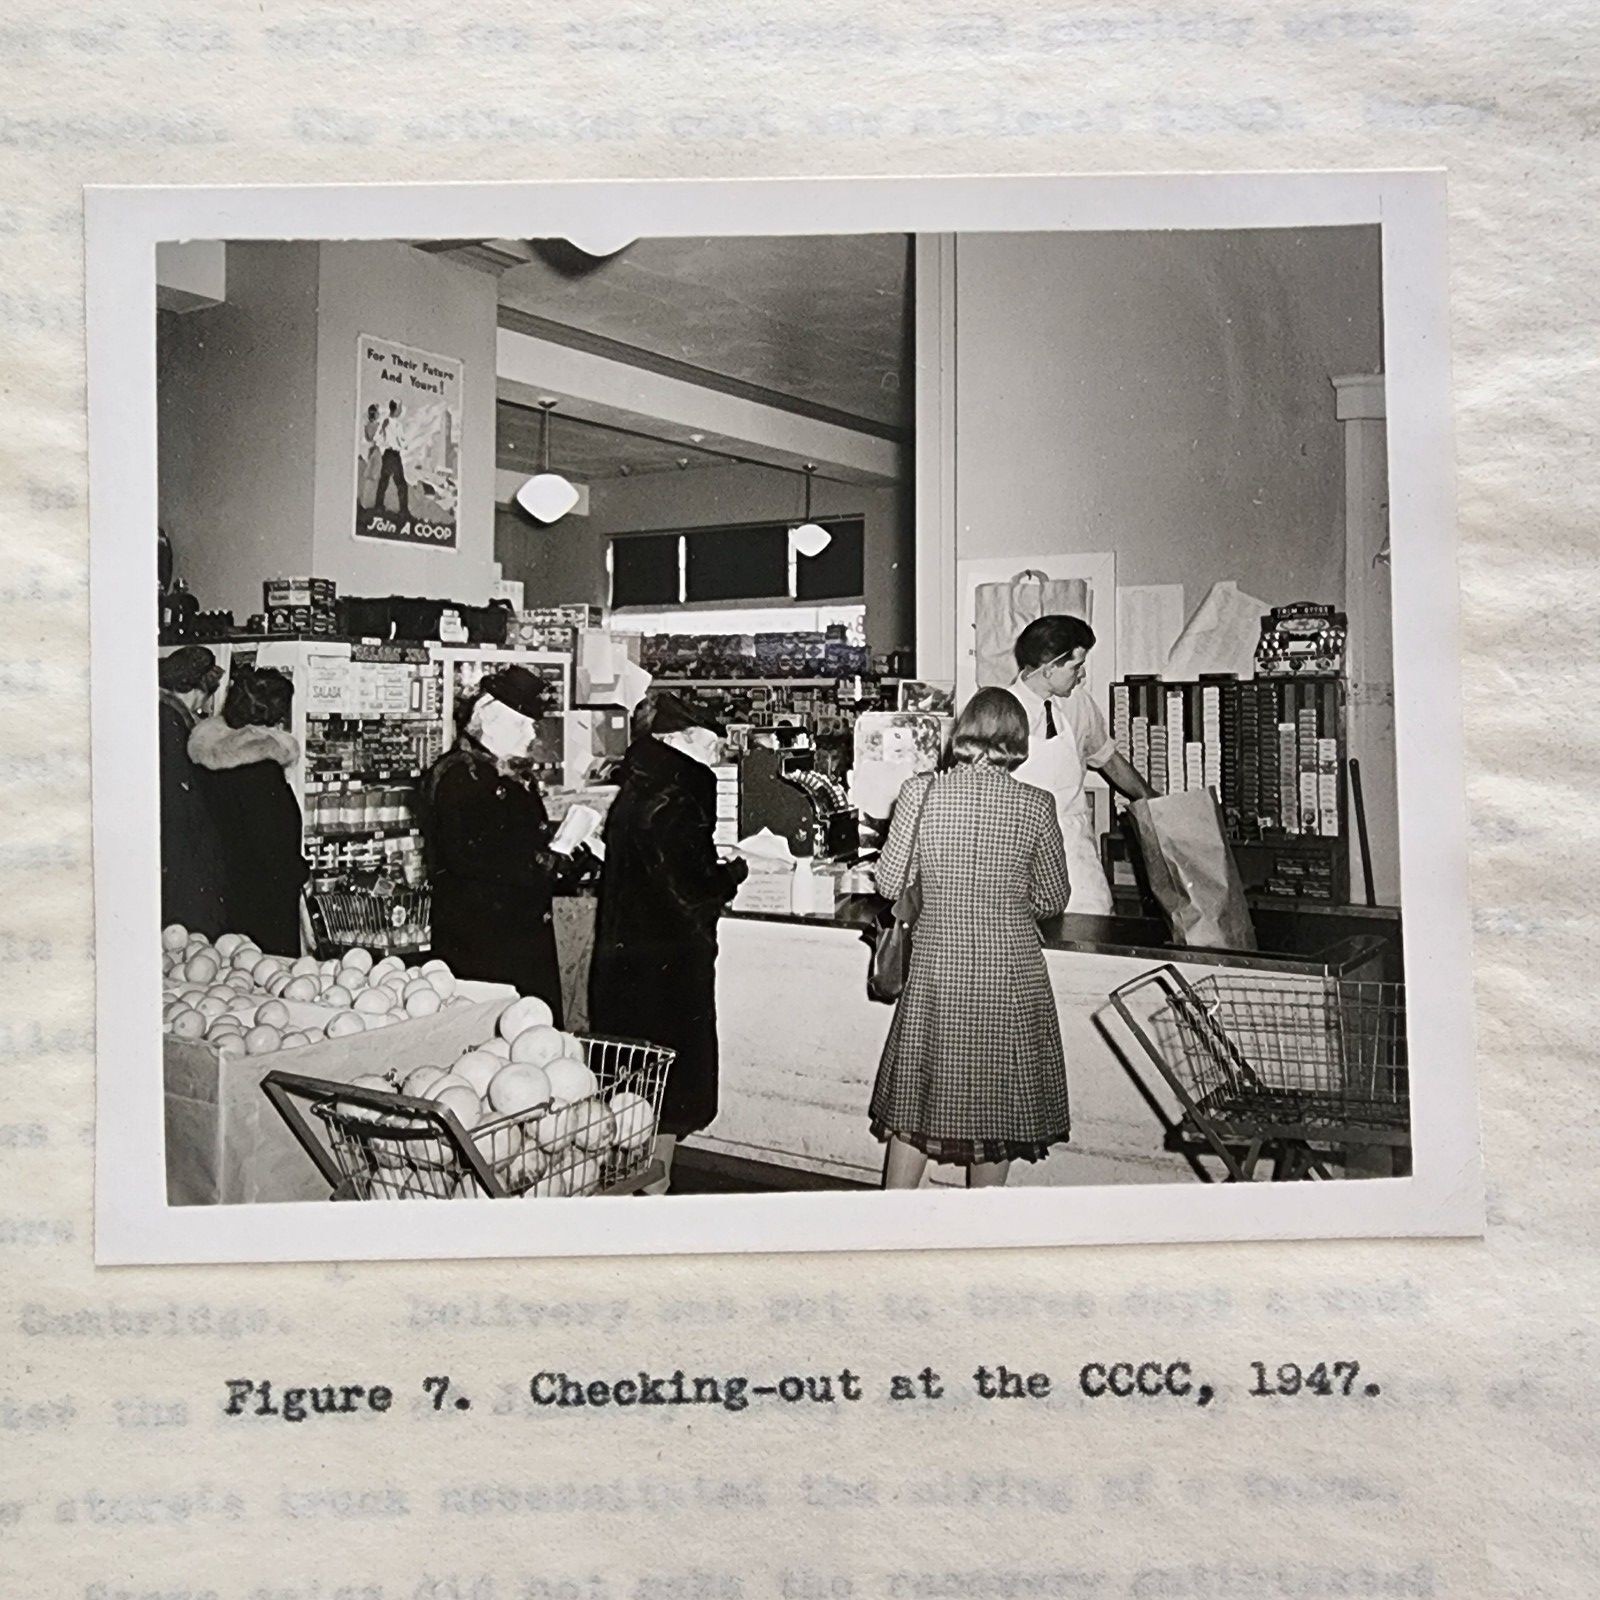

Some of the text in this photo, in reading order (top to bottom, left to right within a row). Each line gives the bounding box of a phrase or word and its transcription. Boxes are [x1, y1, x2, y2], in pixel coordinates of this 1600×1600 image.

[367, 347, 455, 382] For Their Future
[381, 368, 445, 396] And Yours!
[366, 516, 397, 535] Join
[400, 521, 411, 536] A
[225, 1360, 1382, 1423] Figure 7. Checking-out at the CCCC, 1947.
